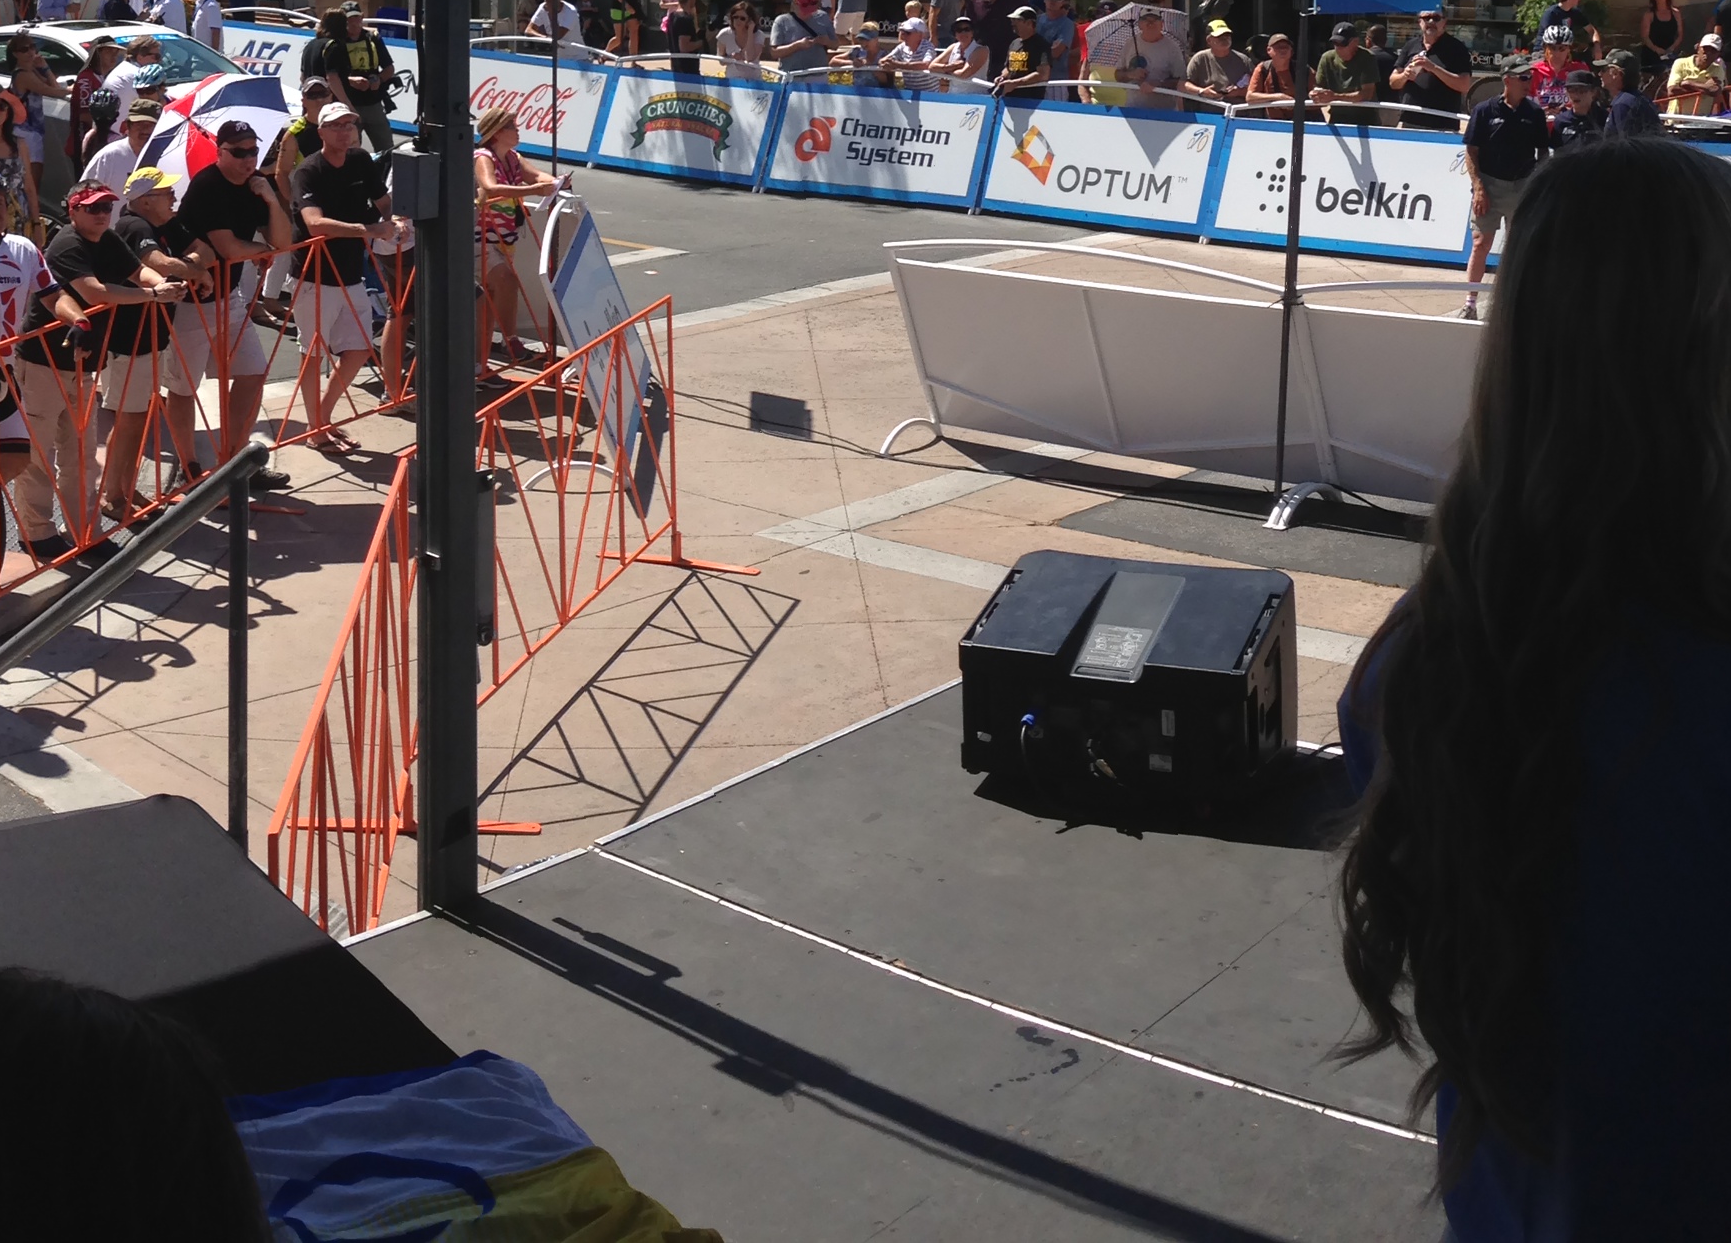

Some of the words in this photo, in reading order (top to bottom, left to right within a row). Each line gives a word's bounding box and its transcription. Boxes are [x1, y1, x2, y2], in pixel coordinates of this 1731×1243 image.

[239, 40, 291, 76] AEG
[469, 76, 578, 134] Coca-Cola
[646, 100, 728, 127] CRUNCHIES
[840, 118, 950, 146] Champion
[846, 141, 935, 168] System
[1057, 165, 1171, 204] OPTUM
[1315, 177, 1433, 222] belkin
